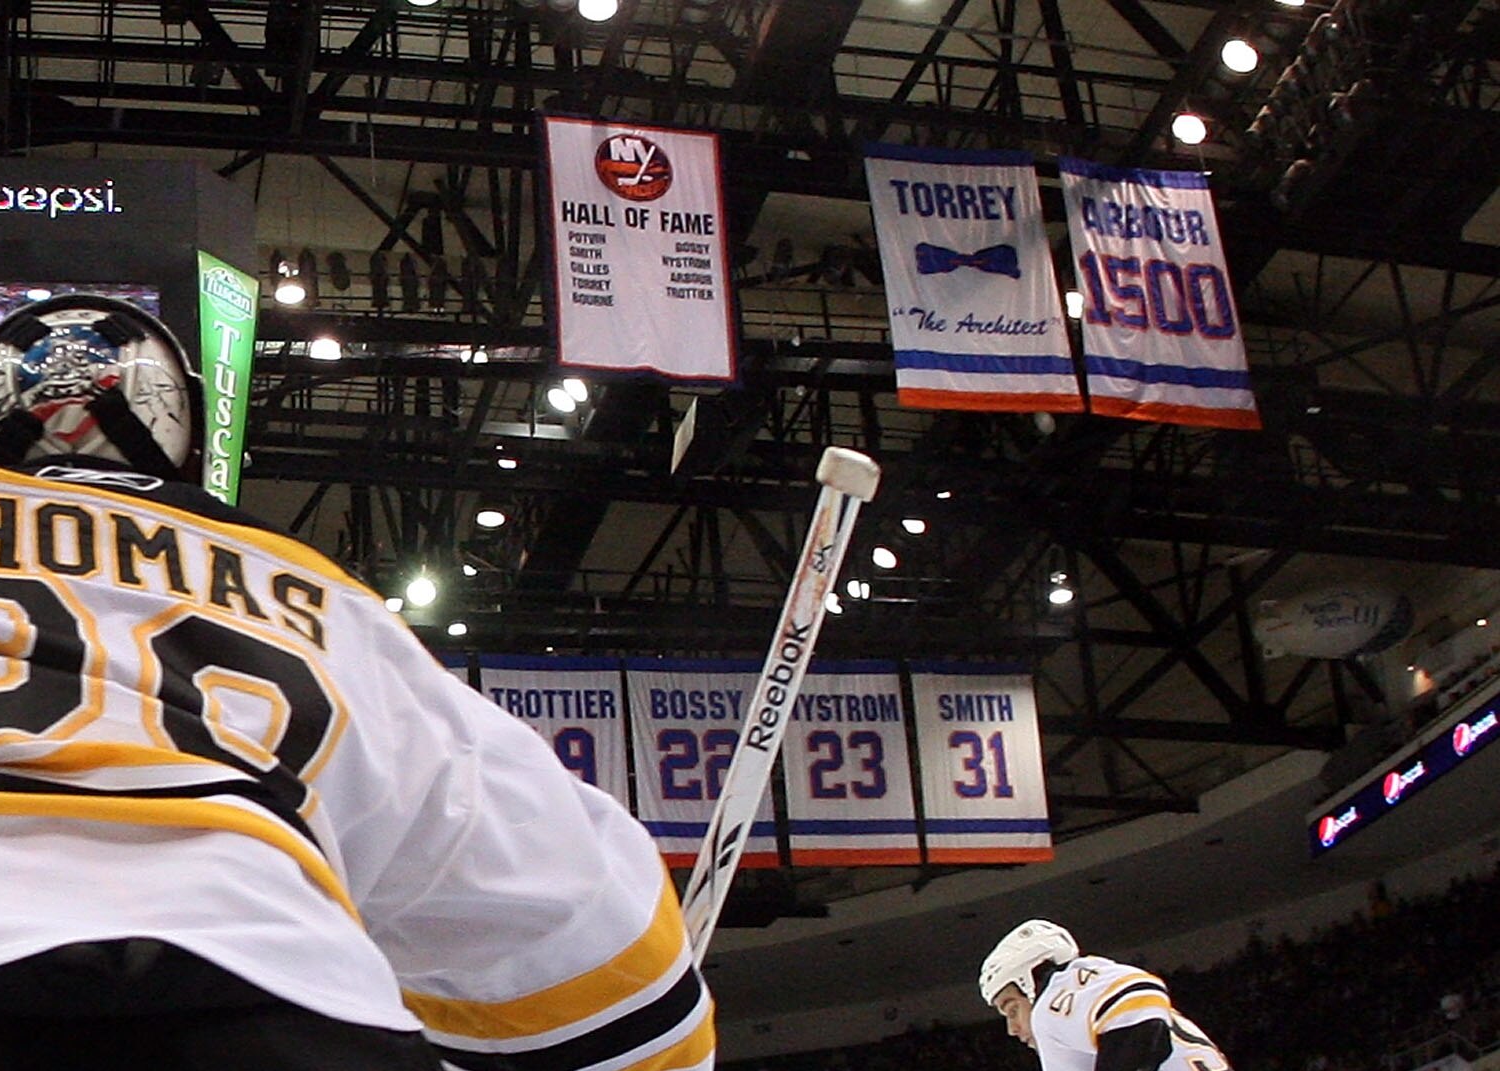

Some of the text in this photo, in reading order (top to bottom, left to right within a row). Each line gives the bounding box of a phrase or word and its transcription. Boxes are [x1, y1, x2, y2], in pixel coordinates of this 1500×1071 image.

[890, 179, 1017, 220] TORREY
[562, 201, 714, 235] HALL OF FAME
[1081, 198, 1209, 246] ARBOUR
[568, 231, 606, 244] POTVIN
[569, 246, 603, 259] SMITH
[570, 261, 609, 275] GILLIES
[662, 256, 711, 269] NYSTROM
[205, 276, 250, 311] Tuscan
[572, 277, 612, 291] TORREY
[666, 287, 714, 300] TROTTIER
[1079, 250, 1236, 340] 1500
[747, 621, 812, 752] Reebok
[490, 688, 616, 719] TROTTIER
[651, 689, 743, 720] BOSSY
[939, 694, 1014, 723] SMITH
[657, 728, 741, 801] 22
[806, 729, 887, 799] 23
[948, 729, 1015, 799] 31
